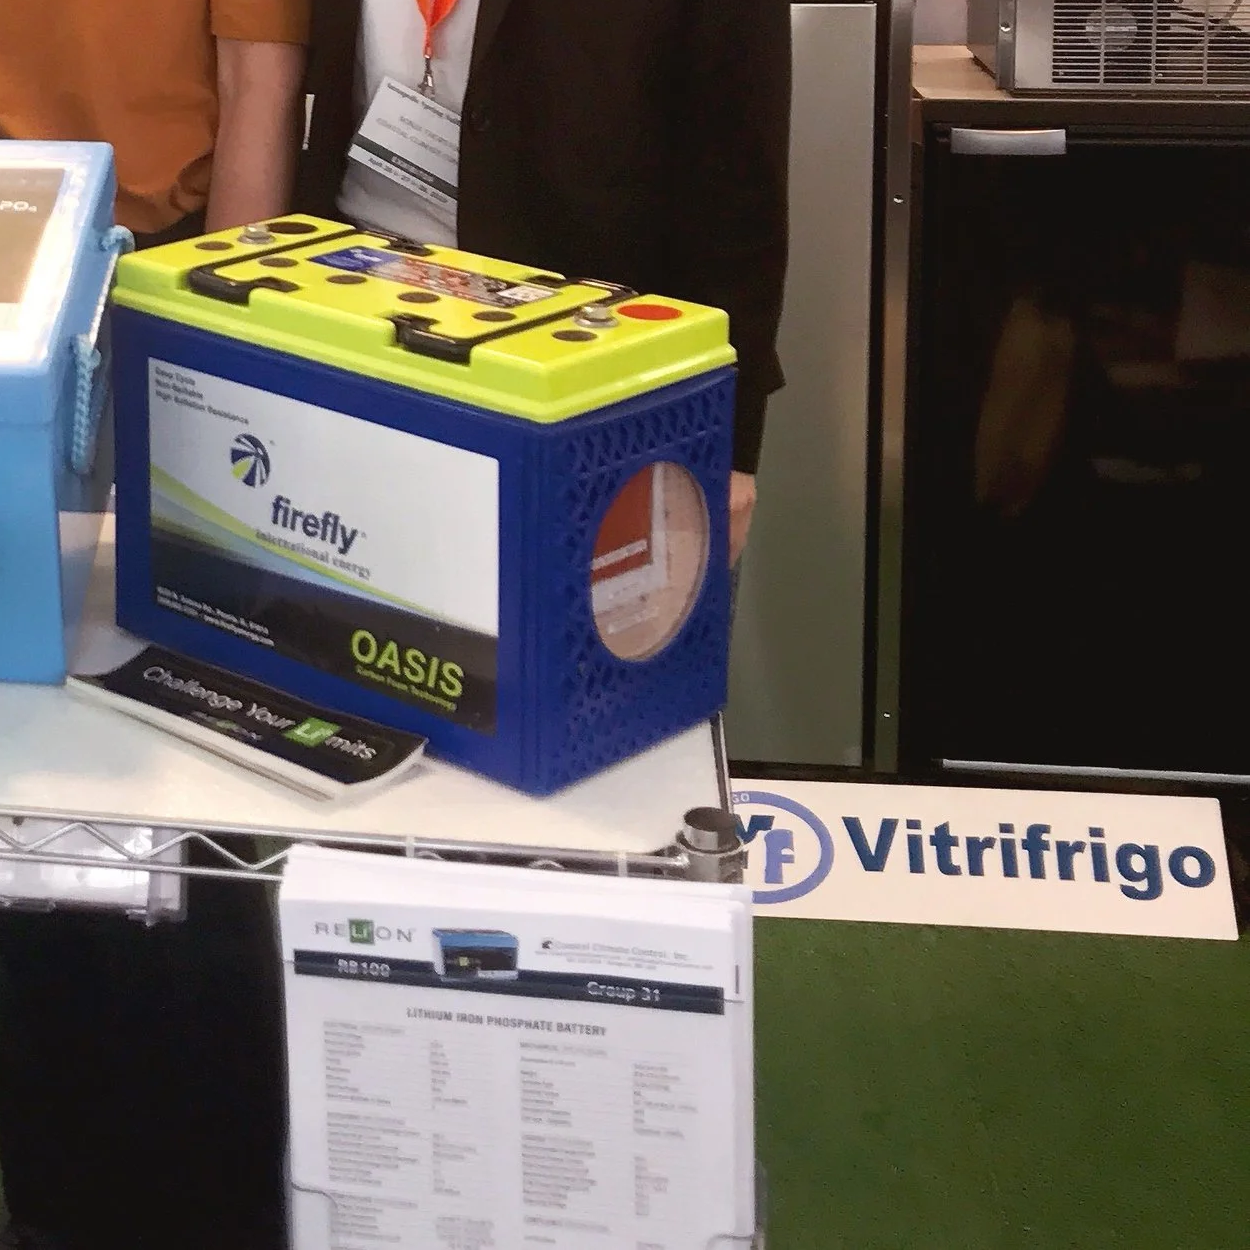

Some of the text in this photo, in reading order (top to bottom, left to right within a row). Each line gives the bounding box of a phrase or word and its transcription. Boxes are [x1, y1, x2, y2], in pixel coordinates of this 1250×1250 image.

[271, 494, 358, 556] firefly
[351, 629, 464, 698] OASIS
[841, 814, 1216, 901] Vitrifrigo
[406, 1007, 607, 1036] LITHIUM IRON PHOSPHATE BATTERY
[586, 981, 636, 1002] Group
